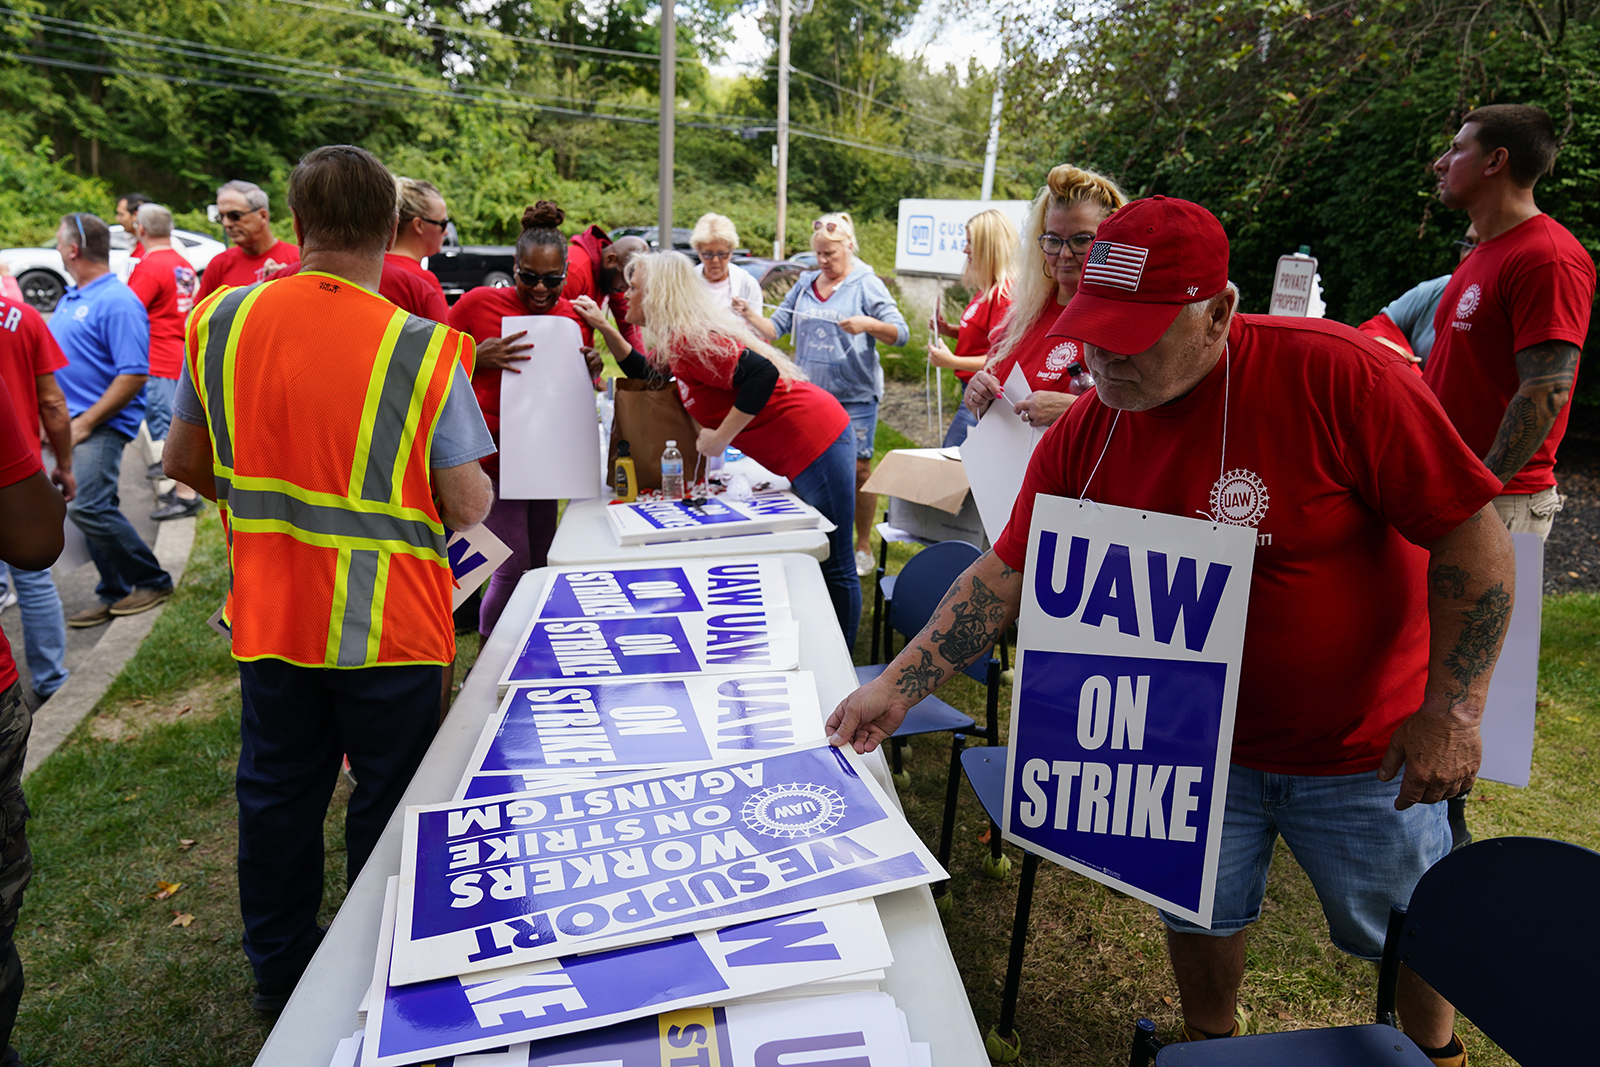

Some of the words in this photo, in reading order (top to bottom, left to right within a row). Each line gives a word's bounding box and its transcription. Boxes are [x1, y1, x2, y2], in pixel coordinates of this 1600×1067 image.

[911, 225, 929, 246] gm
[938, 238, 946, 251] &
[939, 222, 965, 236] CUS
[1273, 293, 1307, 313] PROPERTY
[1279, 272, 1309, 292] PRIVATE
[638, 502, 703, 528] STRIKE
[1224, 492, 1252, 508] UAW
[565, 571, 636, 616] STRIKE
[627, 580, 686, 600] ON
[707, 563, 763, 607] UAW
[1034, 529, 1233, 653] UAW
[543, 621, 623, 677] STRIKE
[614, 633, 682, 656] ON
[706, 611, 772, 666] UAW
[526, 688, 617, 765] STRIKE
[609, 705, 688, 736] ON
[716, 675, 796, 751] UAW
[1076, 674, 1151, 751] ON
[553, 761, 764, 822] AGAINST
[774, 800, 818, 820] UAW
[1019, 757, 1204, 843] STRIKE
[447, 798, 549, 839] GM
[653, 804, 732, 836] ON
[448, 817, 646, 871] STRIKE
[765, 835, 880, 883] WE
[449, 828, 761, 909] WORKERS
[467, 860, 771, 964] SUPPORT
